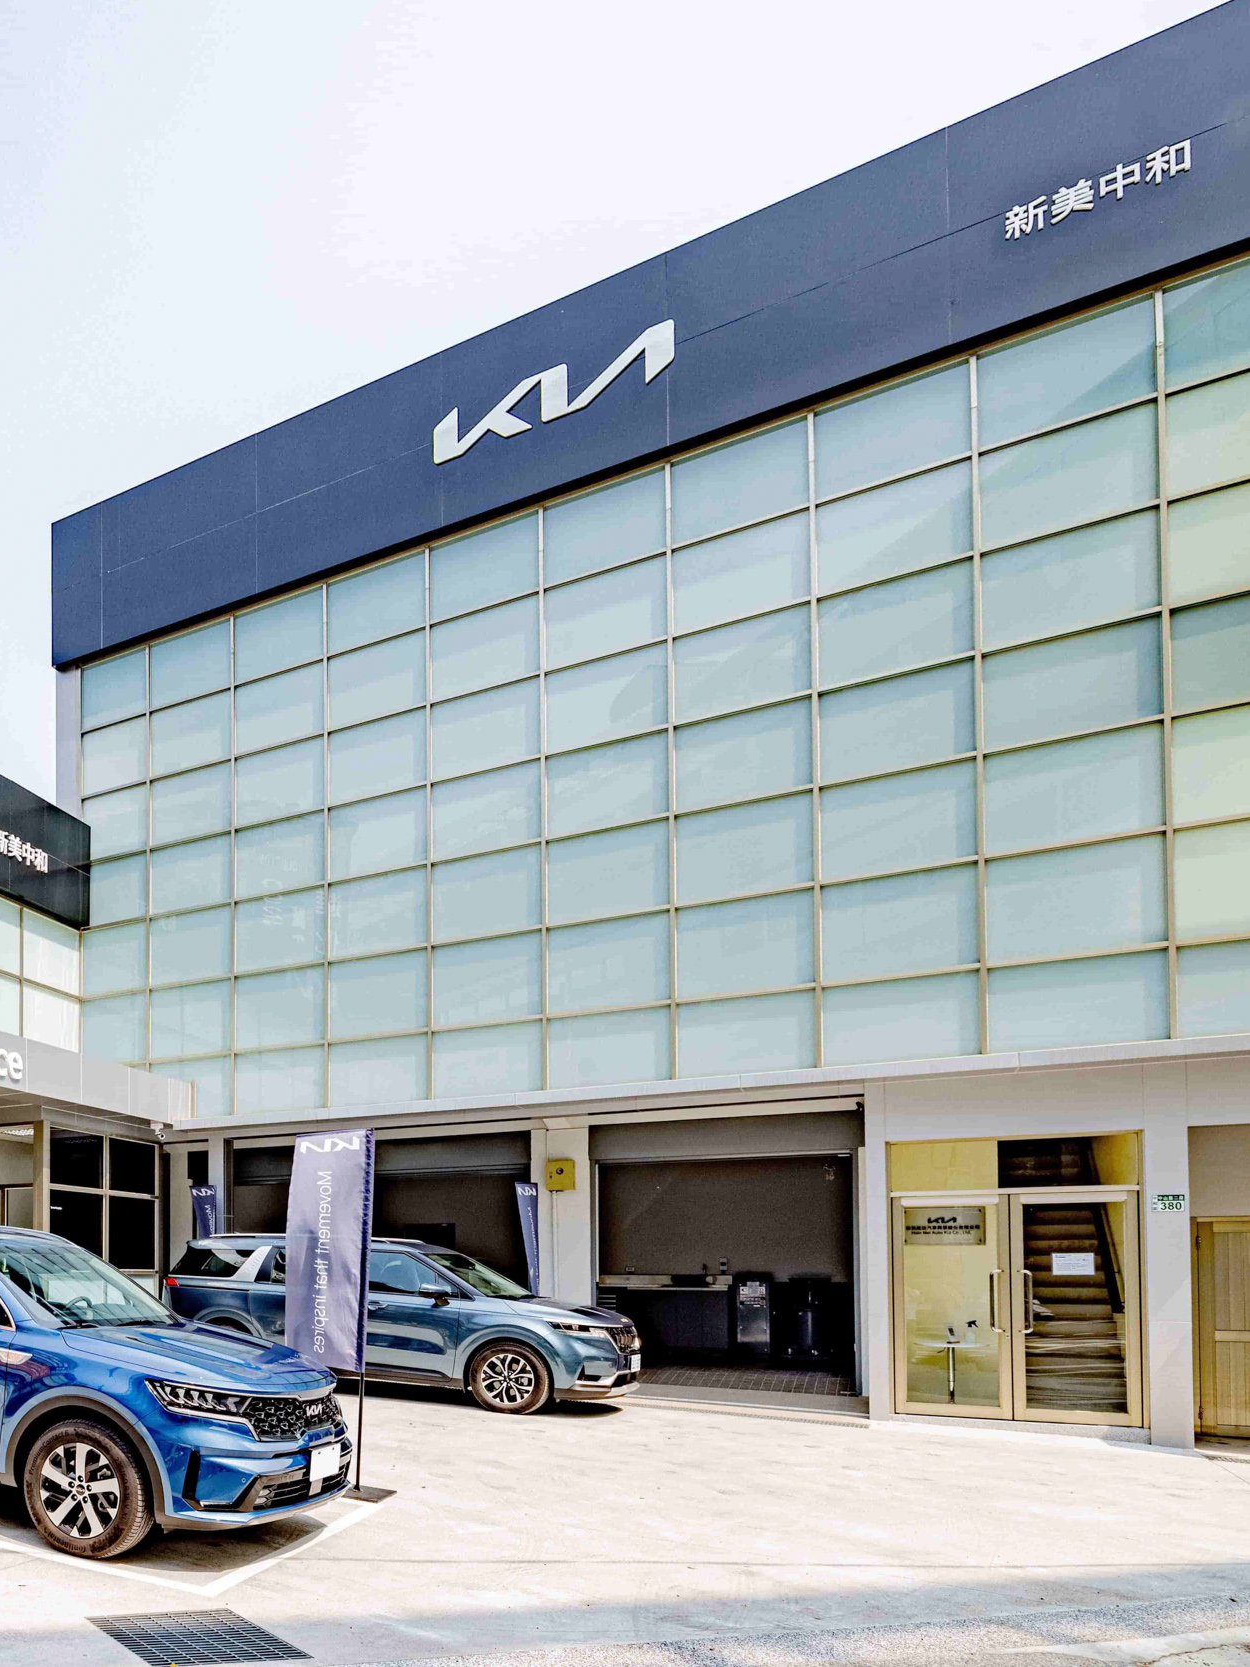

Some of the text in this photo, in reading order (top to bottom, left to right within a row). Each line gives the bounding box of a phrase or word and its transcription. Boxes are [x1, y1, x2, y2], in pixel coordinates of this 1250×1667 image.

[1004, 139, 1192, 240] 新美中和
[433, 318, 675, 465] KIA
[1160, 1202, 1182, 1210] 380
